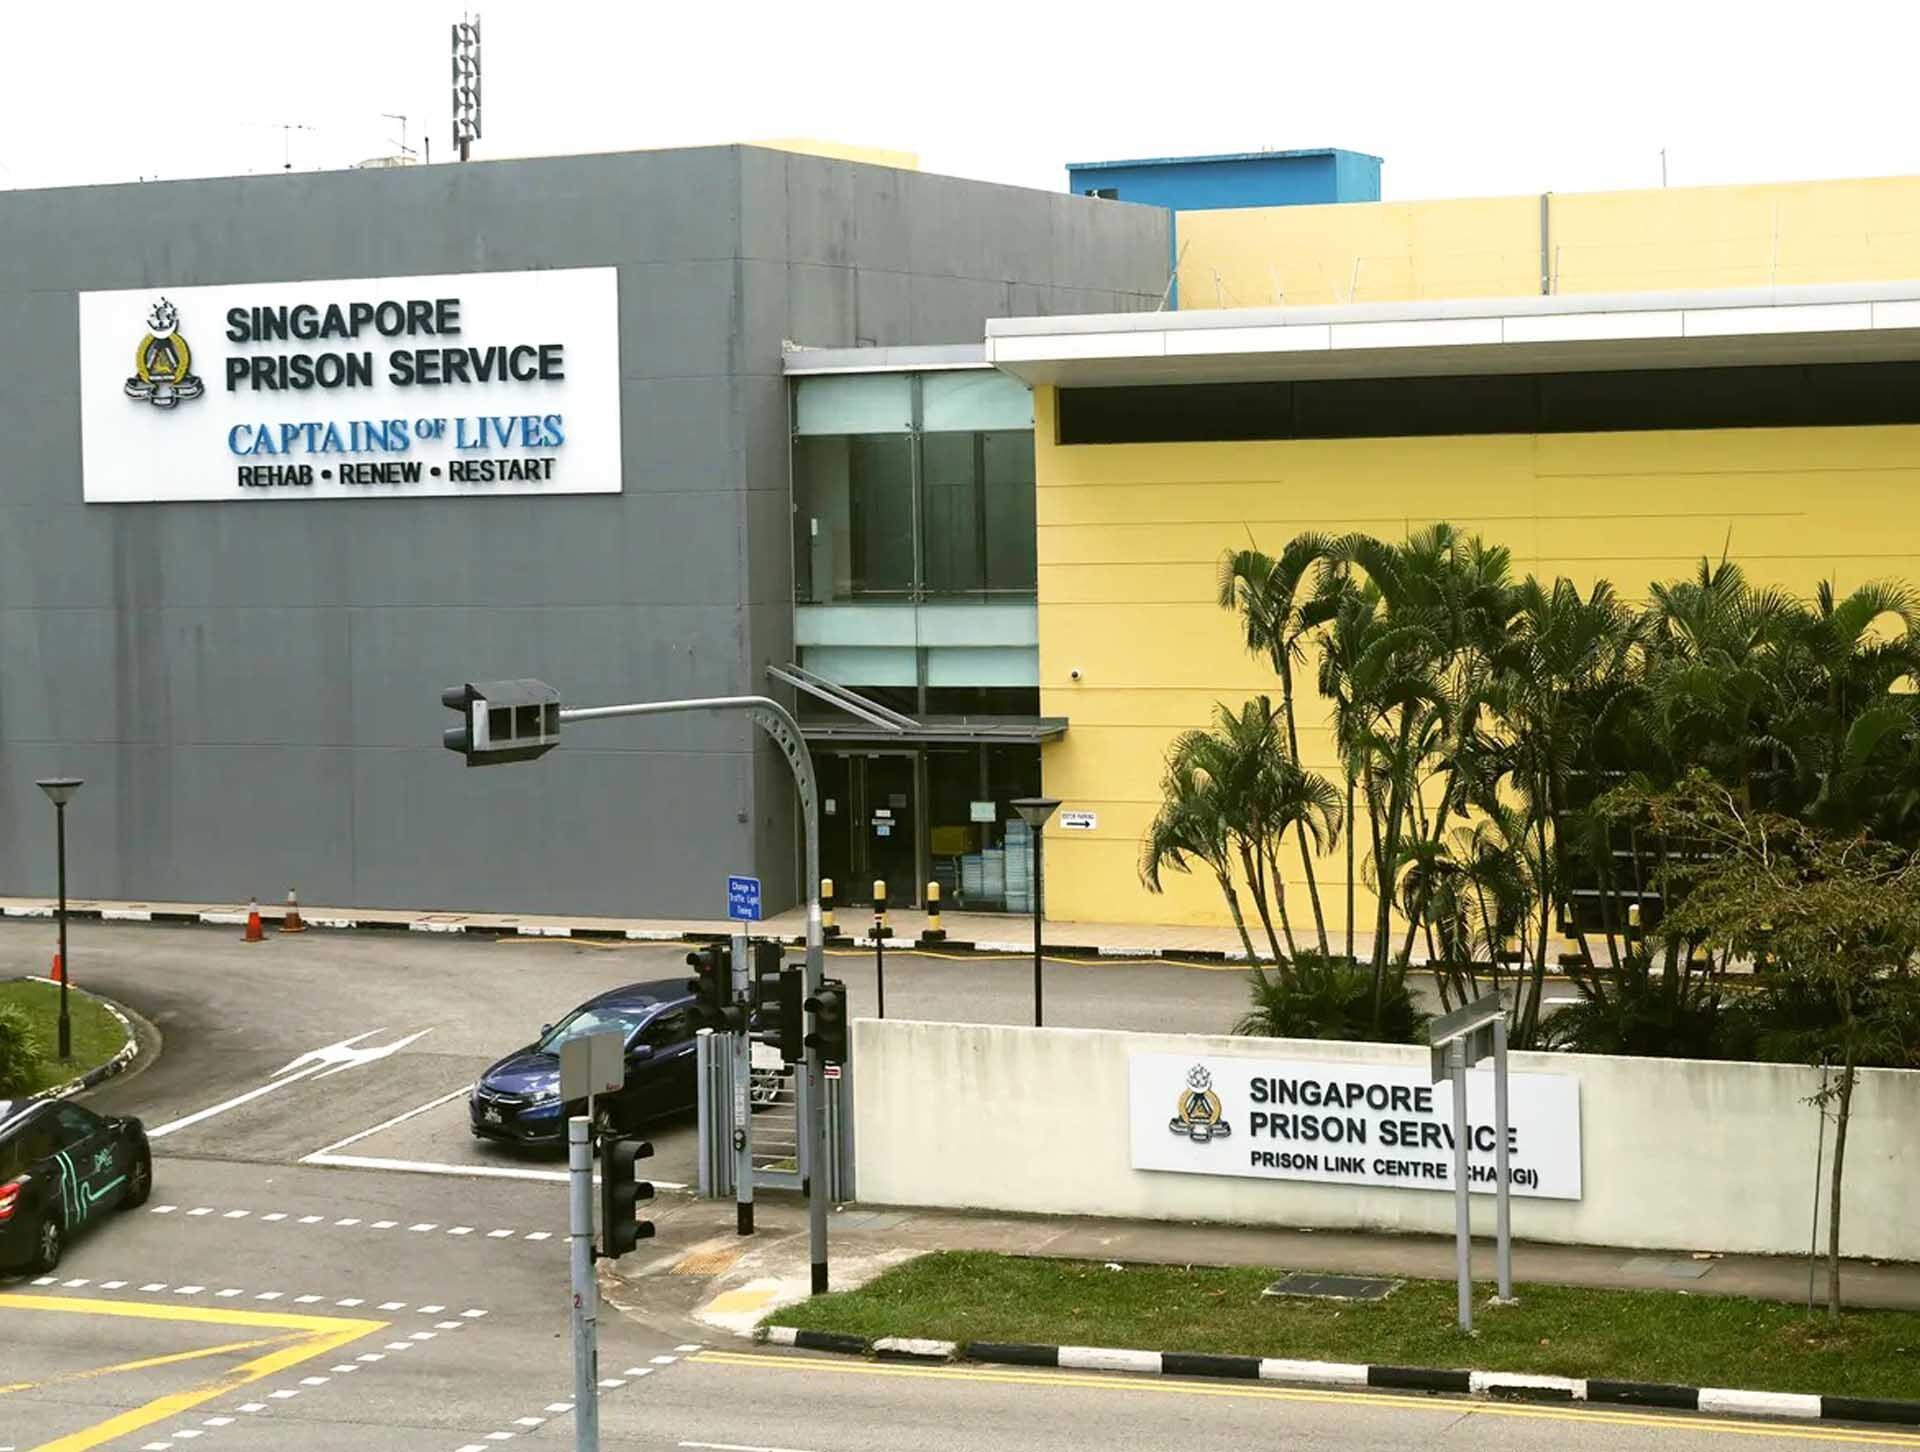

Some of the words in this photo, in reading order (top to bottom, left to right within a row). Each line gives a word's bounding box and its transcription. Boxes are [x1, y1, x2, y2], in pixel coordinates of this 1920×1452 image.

[226, 299, 461, 342] SINGAPORE
[226, 352, 373, 391] PRISON
[388, 344, 565, 386] SERVICE
[228, 419, 410, 455] CAPTAINS
[414, 418, 447, 439] OF
[454, 414, 565, 449] LIVES
[238, 464, 313, 487] REHAB
[339, 462, 422, 485] RENEW
[449, 458, 556, 482] RESTART
[1250, 1077, 1433, 1113] SINGAPORE
[1250, 1112, 1366, 1143] PRISON
[1251, 1151, 1318, 1170] PRISON
[1324, 1156, 1365, 1174] LINK
[1373, 1159, 1448, 1180] CENTRE
